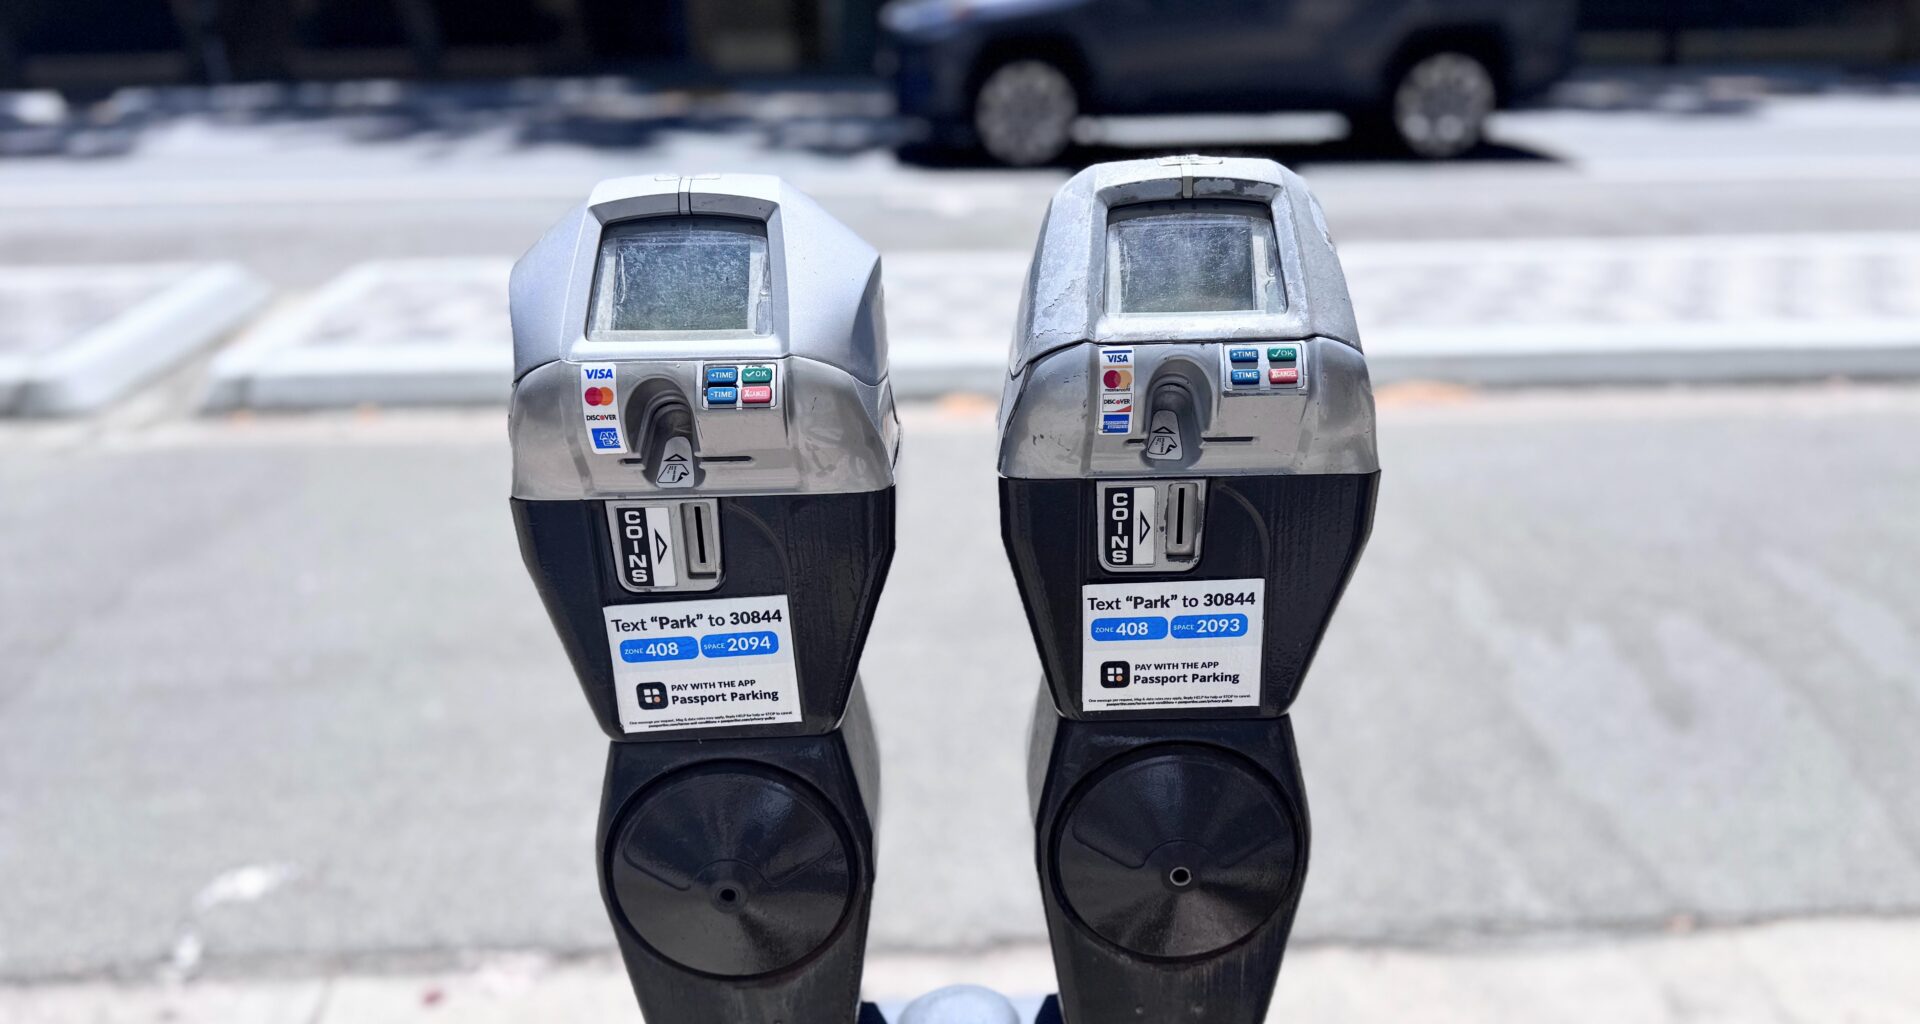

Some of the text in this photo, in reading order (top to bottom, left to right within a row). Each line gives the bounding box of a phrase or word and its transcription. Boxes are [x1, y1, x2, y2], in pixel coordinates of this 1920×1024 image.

[1107, 354, 1129, 363] VISA
[584, 368, 614, 380] VISA
[1111, 492, 1129, 563] COINS
[624, 510, 648, 583] COINS
[1087, 597, 1121, 611] Text
[1182, 595, 1199, 608] to
[1203, 592, 1256, 607] 30844
[611, 618, 648, 633] Text
[708, 614, 726, 627] to
[729, 609, 783, 625] 30844
[1196, 618, 1241, 633] 2093
[1115, 622, 1149, 636] 408
[645, 642, 679, 657] 408
[727, 635, 771, 652] 2094
[1134, 663, 1152, 671] PAY
[1181, 662, 1199, 670] THE
[1200, 661, 1219, 669] APP
[690, 682, 716, 690] WITH
[718, 680, 736, 688] THE
[737, 679, 756, 687] APP
[1133, 672, 1240, 686] Passport Parking
[671, 689, 779, 706] Passport Parking
